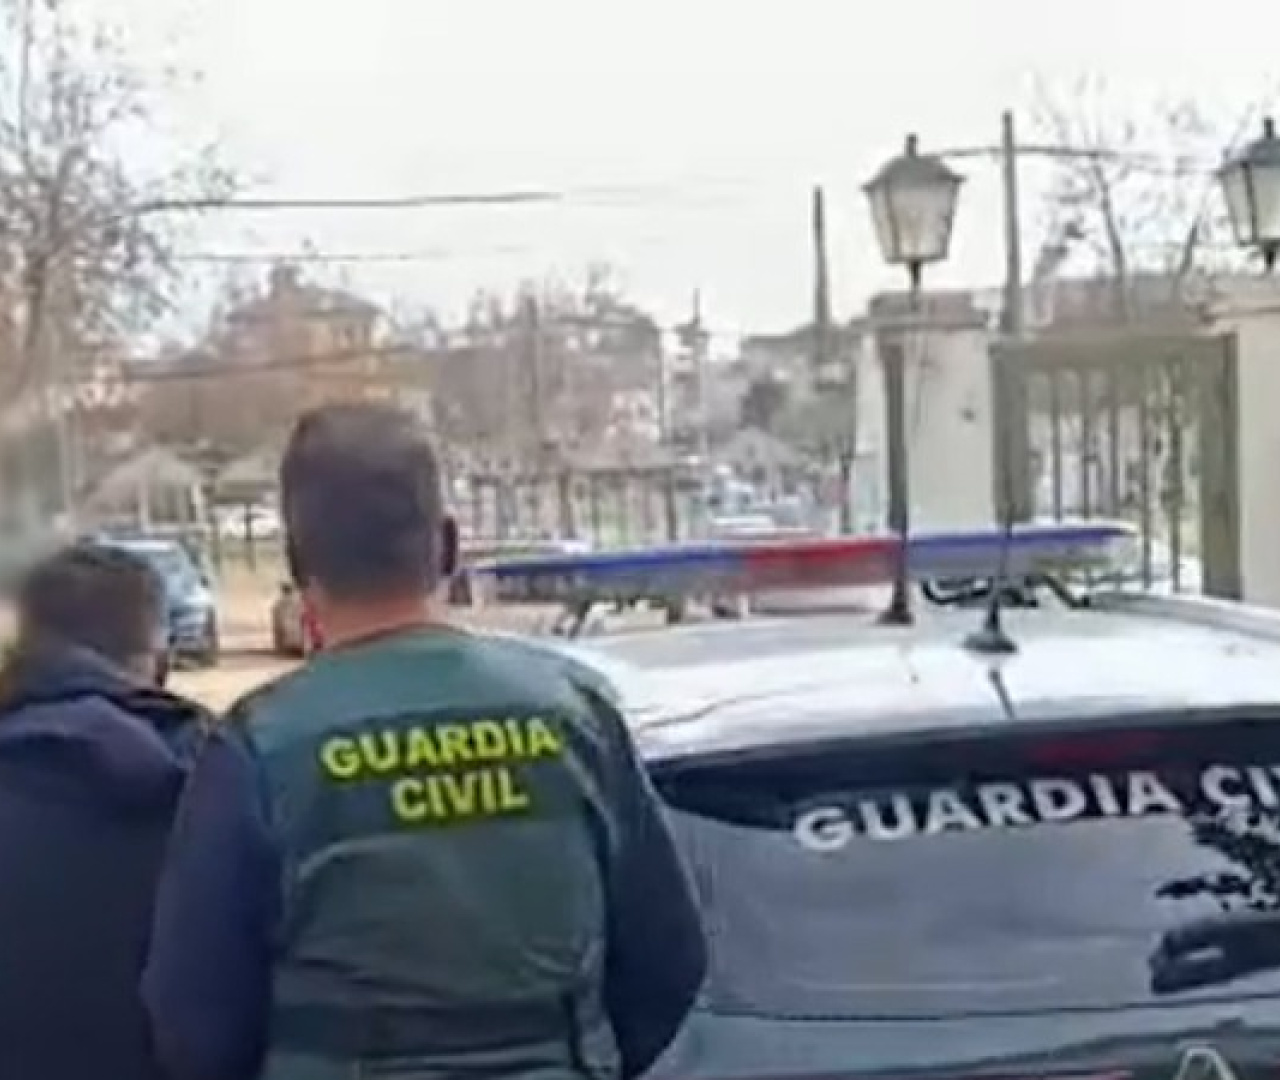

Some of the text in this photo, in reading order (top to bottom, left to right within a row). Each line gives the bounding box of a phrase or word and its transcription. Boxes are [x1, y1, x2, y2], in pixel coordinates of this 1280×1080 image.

[321, 715, 562, 778] GUARDIA
[390, 767, 529, 821] CIVIL
[793, 771, 1181, 851] GUARDIA
